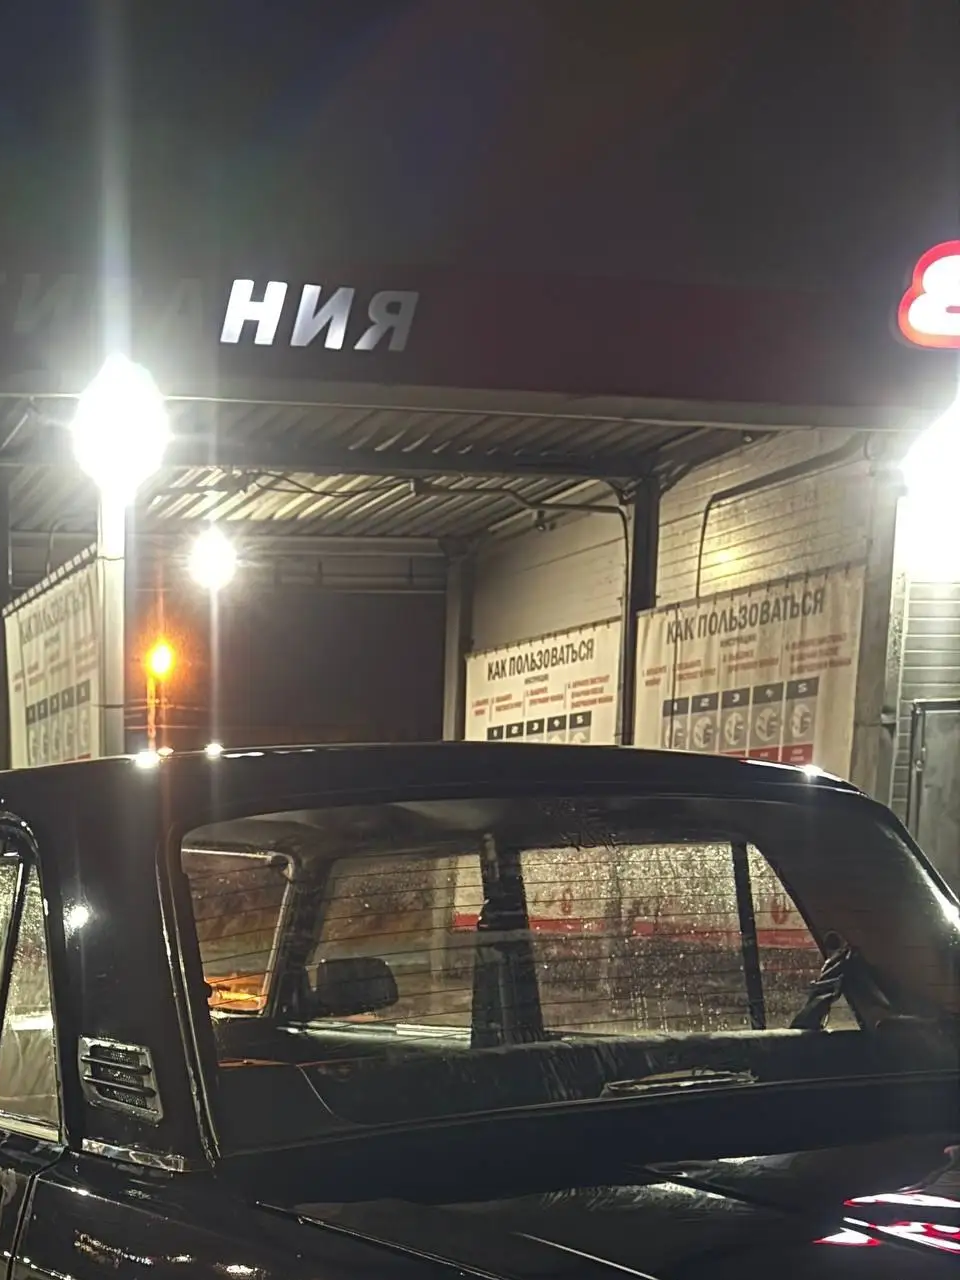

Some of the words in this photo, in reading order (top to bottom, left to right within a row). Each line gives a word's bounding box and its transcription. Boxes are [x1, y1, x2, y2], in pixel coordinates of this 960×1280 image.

[666, 616, 695, 645] КАК
[697, 587, 826, 638] ПОЛЬЗОВАТЬСЯ
[487, 658, 507, 681] КАК
[508, 638, 594, 675] ПОЛЬЗОВАТЬСЯ
[700, 697, 710, 707] 2
[798, 683, 808, 694] 5
[532, 722, 539, 731] 3
[576, 715, 584, 724] 5
